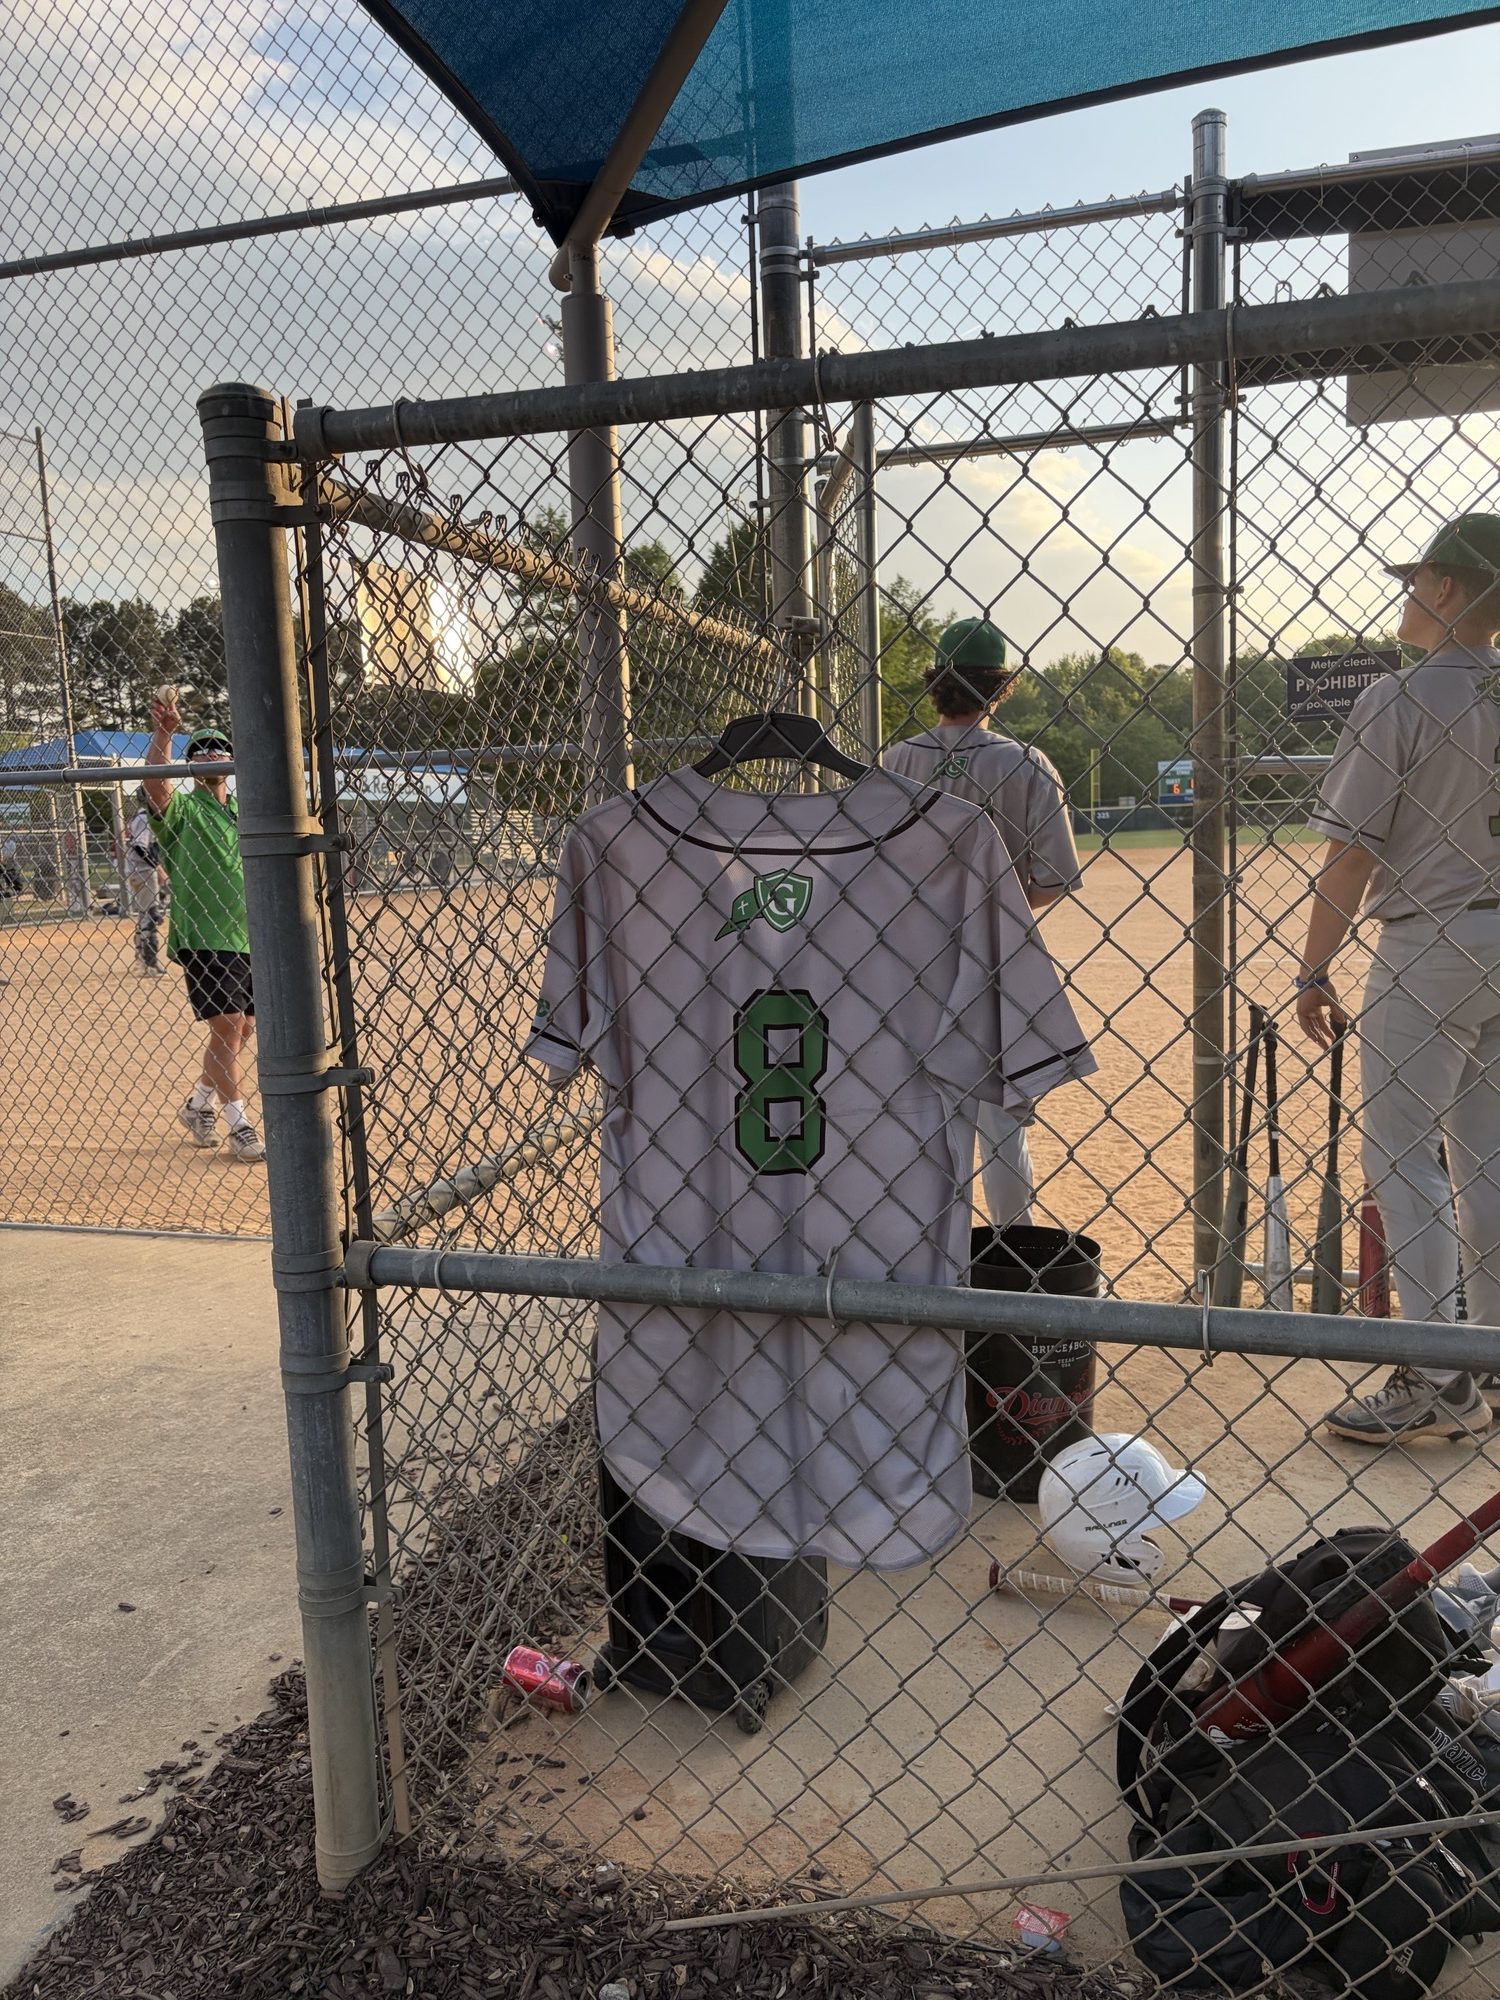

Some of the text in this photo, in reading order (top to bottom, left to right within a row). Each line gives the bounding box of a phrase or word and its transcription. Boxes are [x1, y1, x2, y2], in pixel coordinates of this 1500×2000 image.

[1310, 656, 1376, 669] Meta cleats
[1307, 698, 1351, 710] poable
[767, 883, 798, 916] G
[733, 989, 829, 1176] 8
